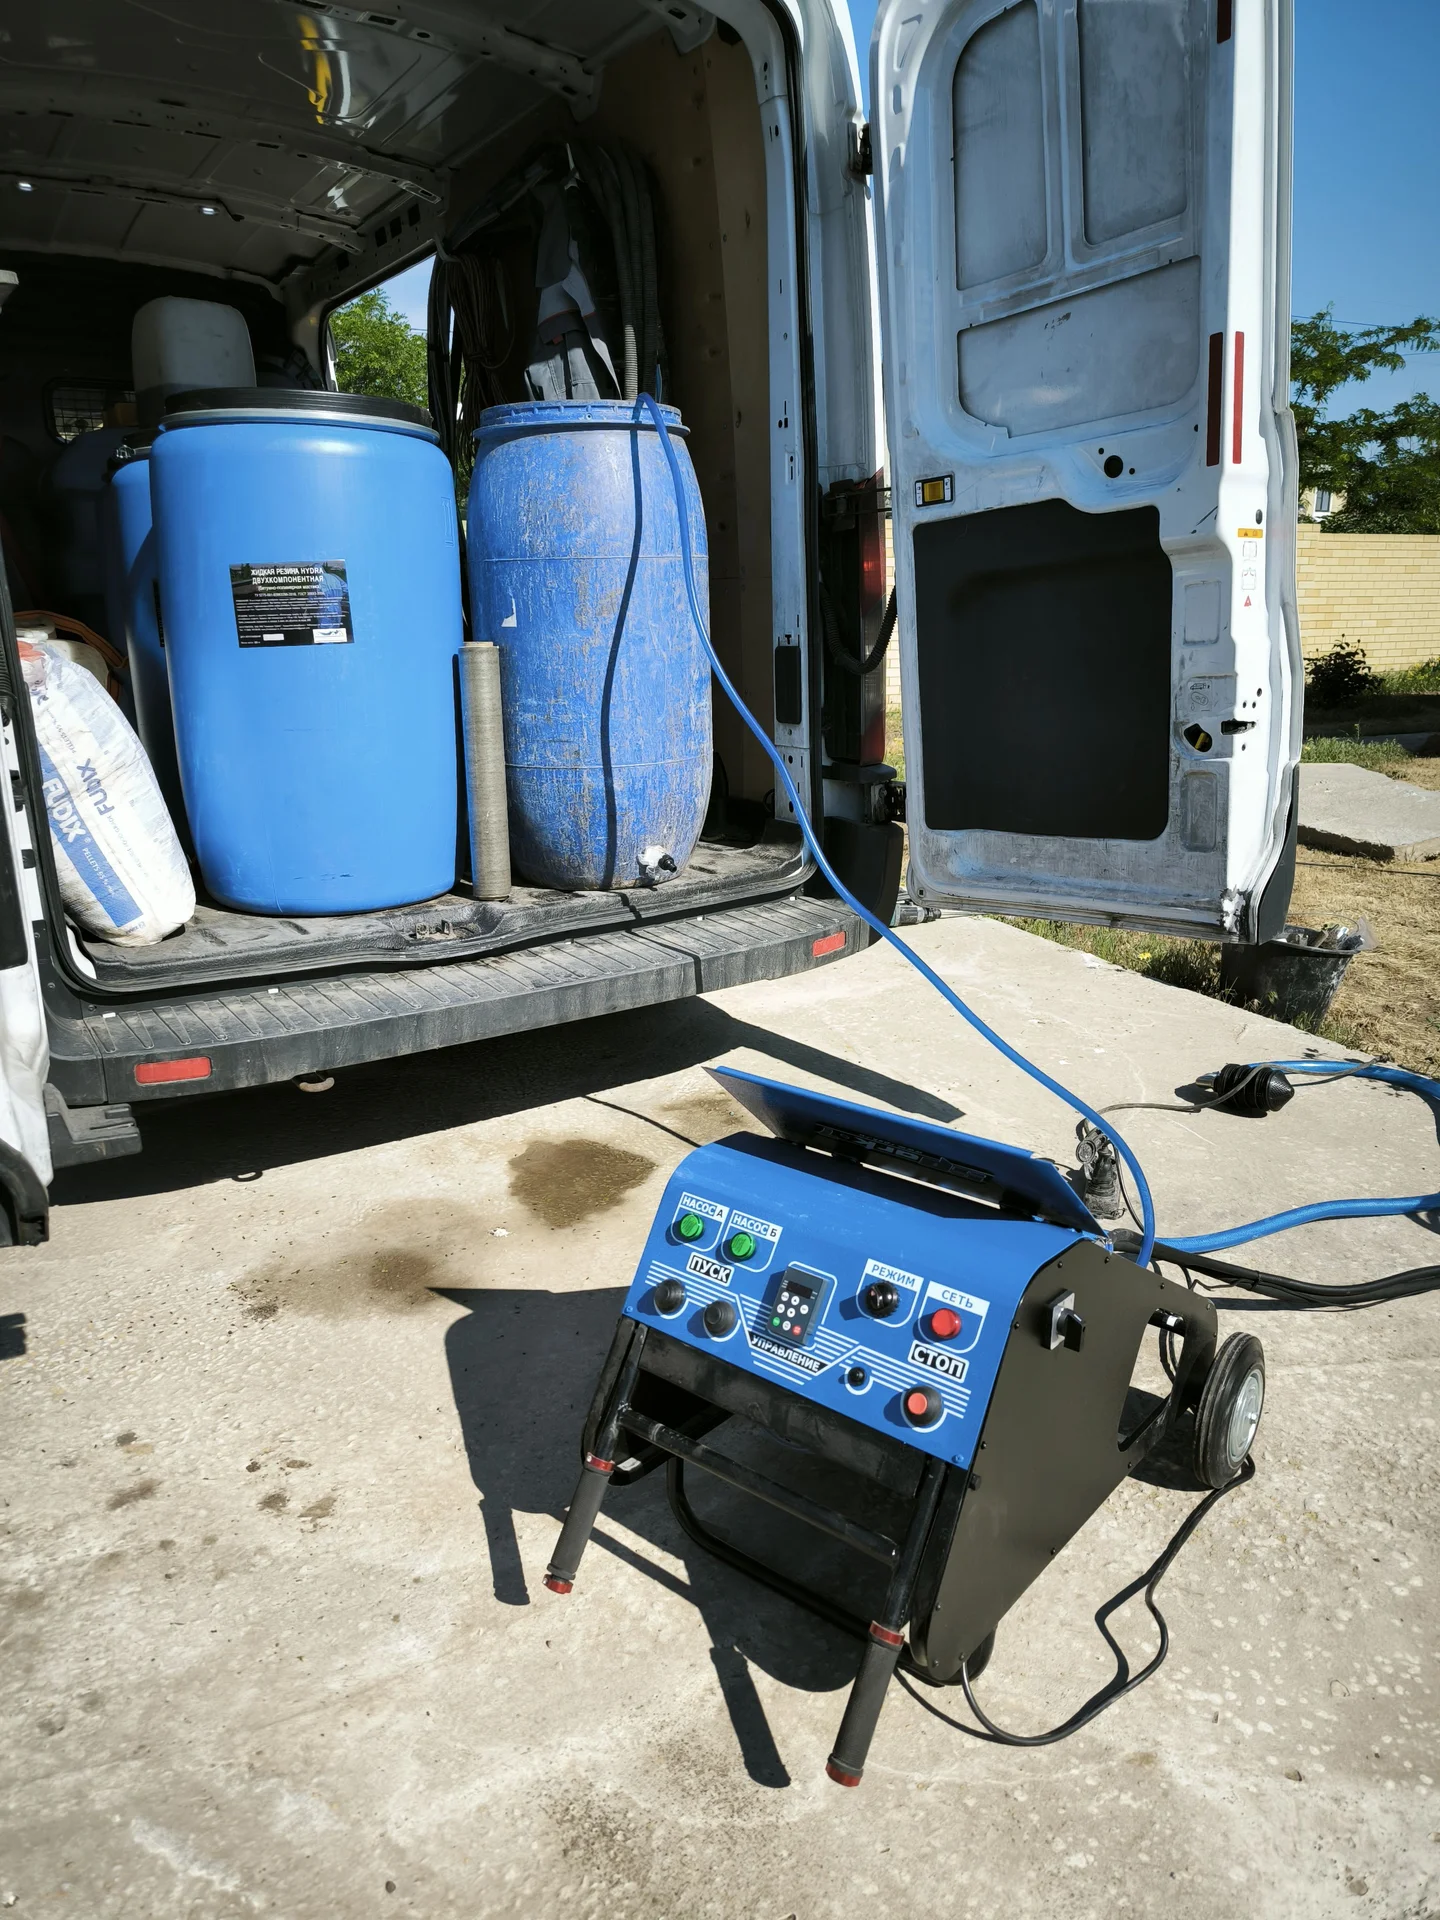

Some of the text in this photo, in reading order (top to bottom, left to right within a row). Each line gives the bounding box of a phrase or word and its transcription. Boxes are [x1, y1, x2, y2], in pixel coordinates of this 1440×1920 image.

[251, 568, 275, 576] ЖИДКАЯ
[300, 567, 324, 575] HYDRA
[252, 575, 324, 585] ДВУХКОМПОНЕНТНАЯ
[76, 758, 115, 815] FUDIX
[42, 777, 86, 843] FUDIX
[82, 847, 100, 872] PELLETS
[682, 1196, 724, 1218] НАСОС А
[733, 1214, 778, 1238] НАСОС Б
[689, 1256, 731, 1283] ПУСК
[871, 1264, 916, 1288] РЕЖИМ
[941, 1289, 973, 1309] СЕТЬ
[751, 1334, 821, 1373] УПРАВЛЕНИЕ
[913, 1346, 964, 1378] СТОП
